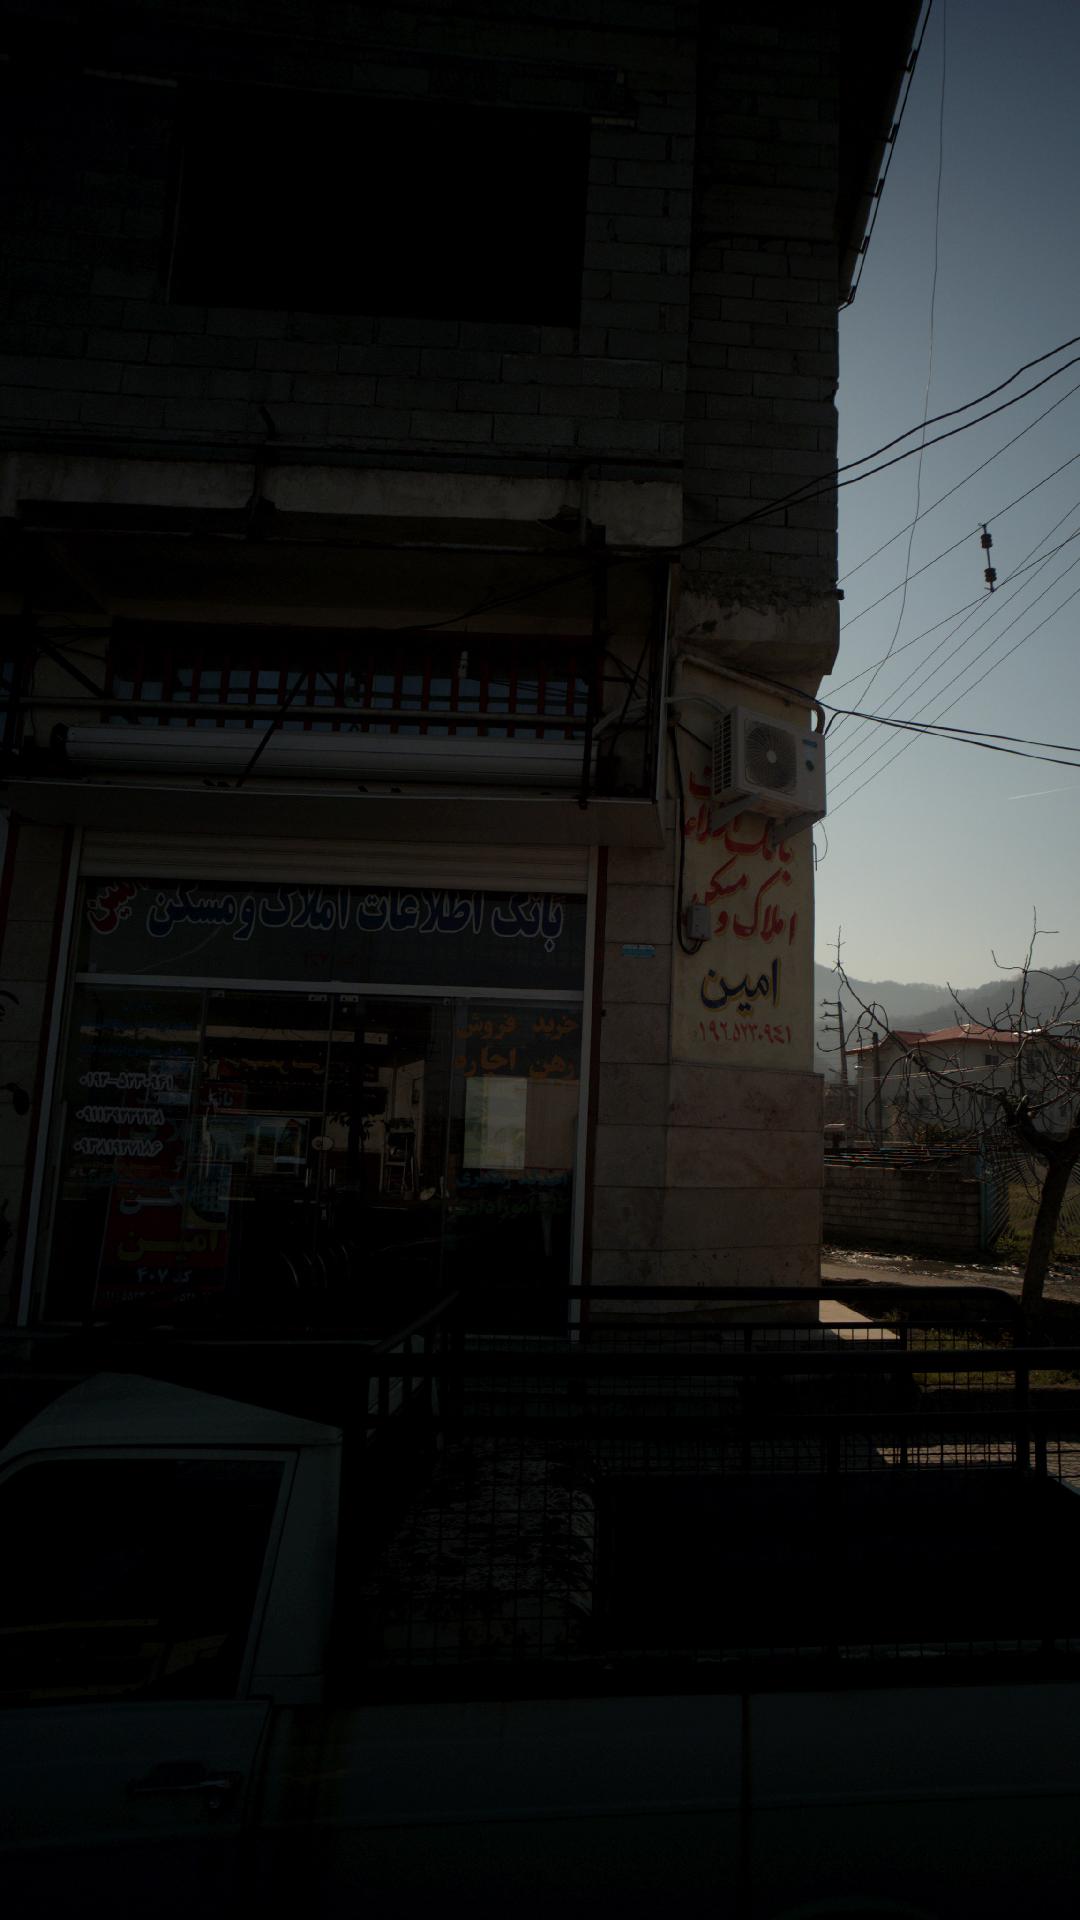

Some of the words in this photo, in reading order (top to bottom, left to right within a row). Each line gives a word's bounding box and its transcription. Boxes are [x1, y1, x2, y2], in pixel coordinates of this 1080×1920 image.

[146, 884, 237, 938] مسکن
[233, 894, 256, 941] و
[259, 886, 351, 931] املاک
[355, 887, 485, 934] اطلاعات
[491, 892, 564, 952] بانک
[714, 911, 729, 944] و
[732, 868, 798, 946] املاک
[701, 959, 781, 1017] امین
[455, 1011, 520, 1041] فروش
[532, 1011, 578, 1041] خرید
[452, 1046, 517, 1077] اجاره
[528, 1054, 576, 1080] رهن
[117, 1229, 218, 1261] امین
